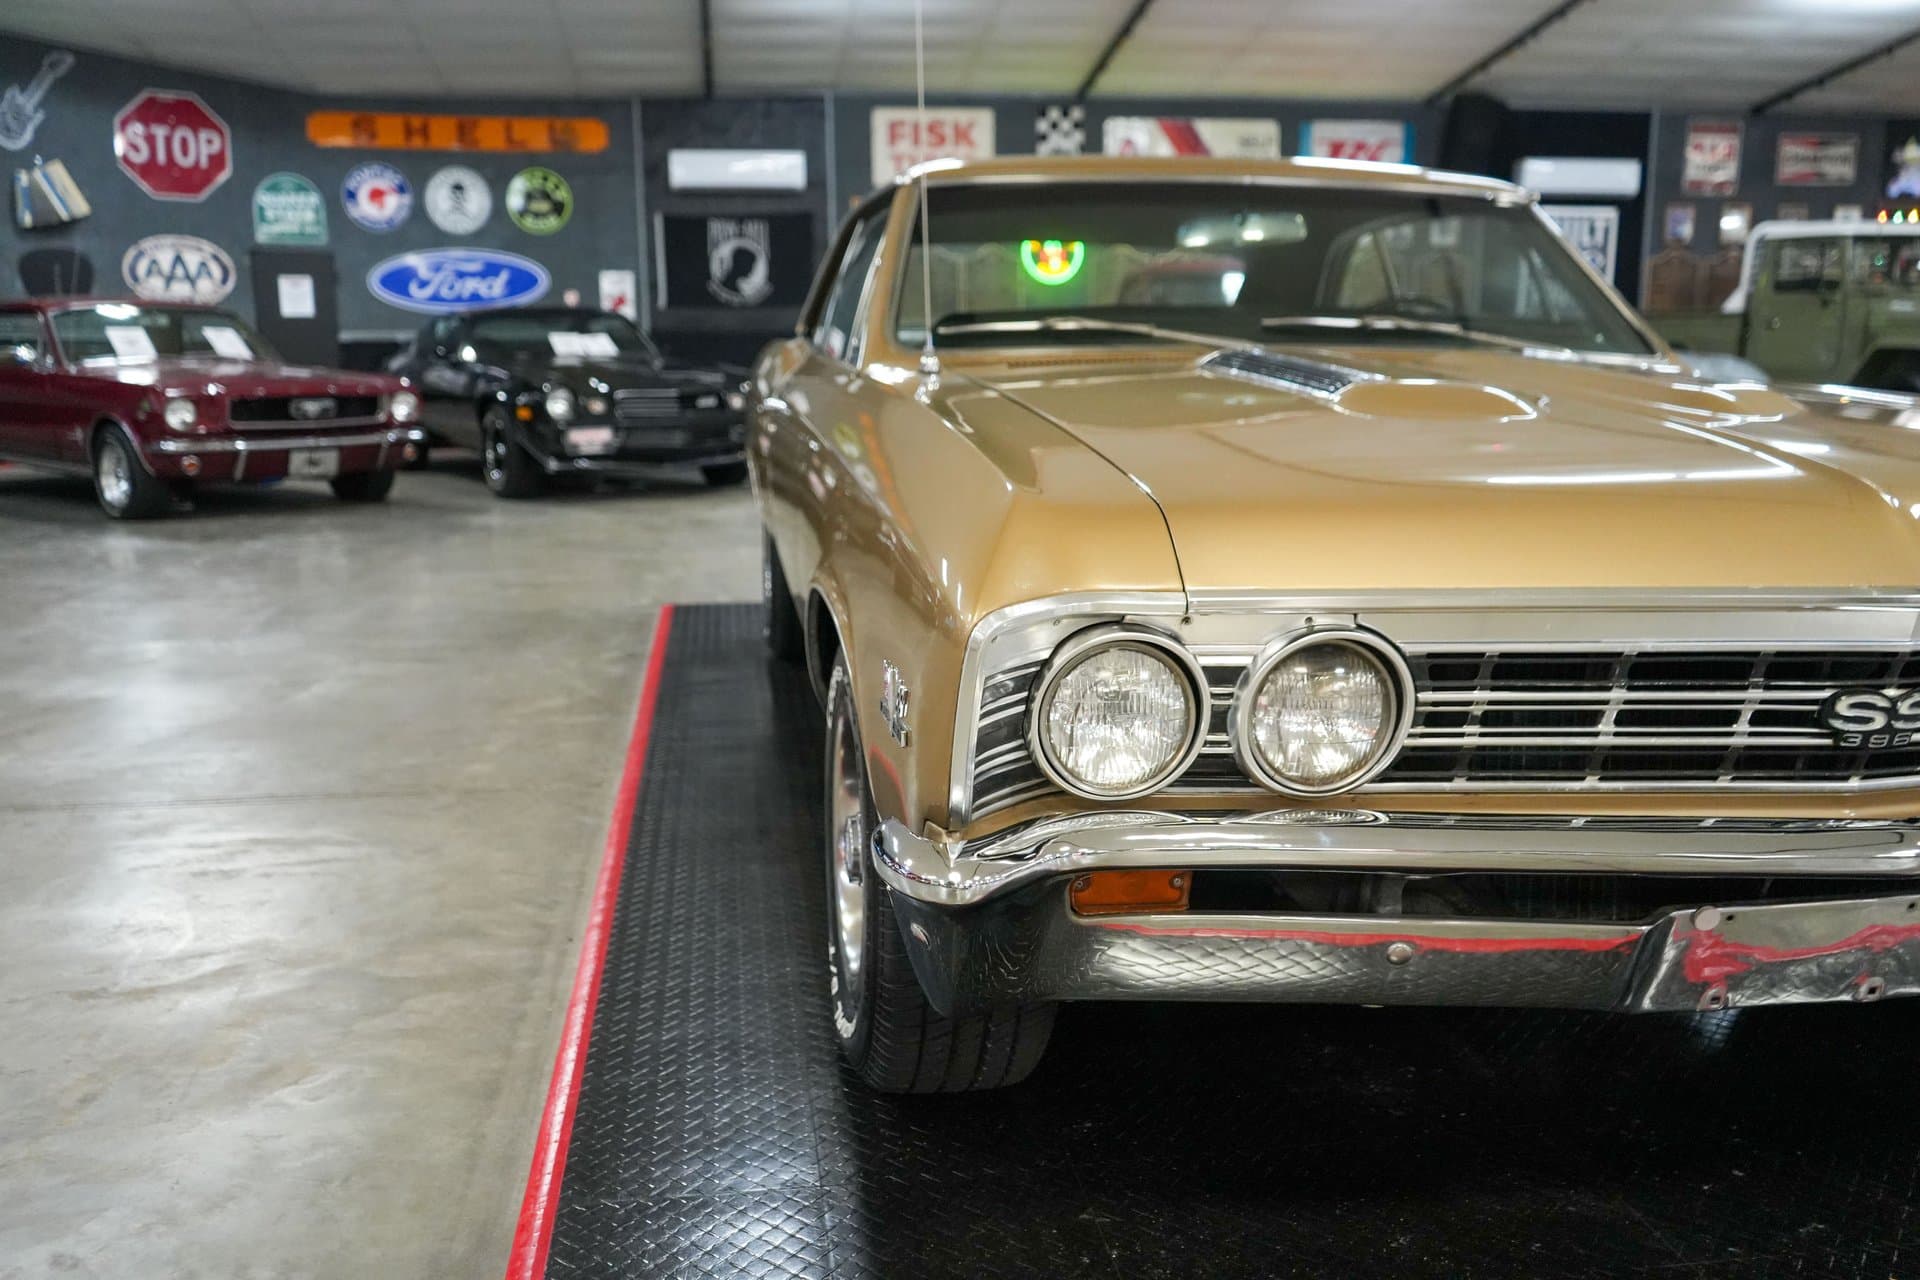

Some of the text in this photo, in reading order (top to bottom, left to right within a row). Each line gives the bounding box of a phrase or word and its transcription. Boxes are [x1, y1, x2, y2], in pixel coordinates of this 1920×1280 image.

[124, 120, 223, 170] STOP
[887, 119, 977, 148] FISK
[145, 251, 214, 289] AAA
[406, 256, 511, 300] Ford
[1840, 732, 1912, 748] 396
